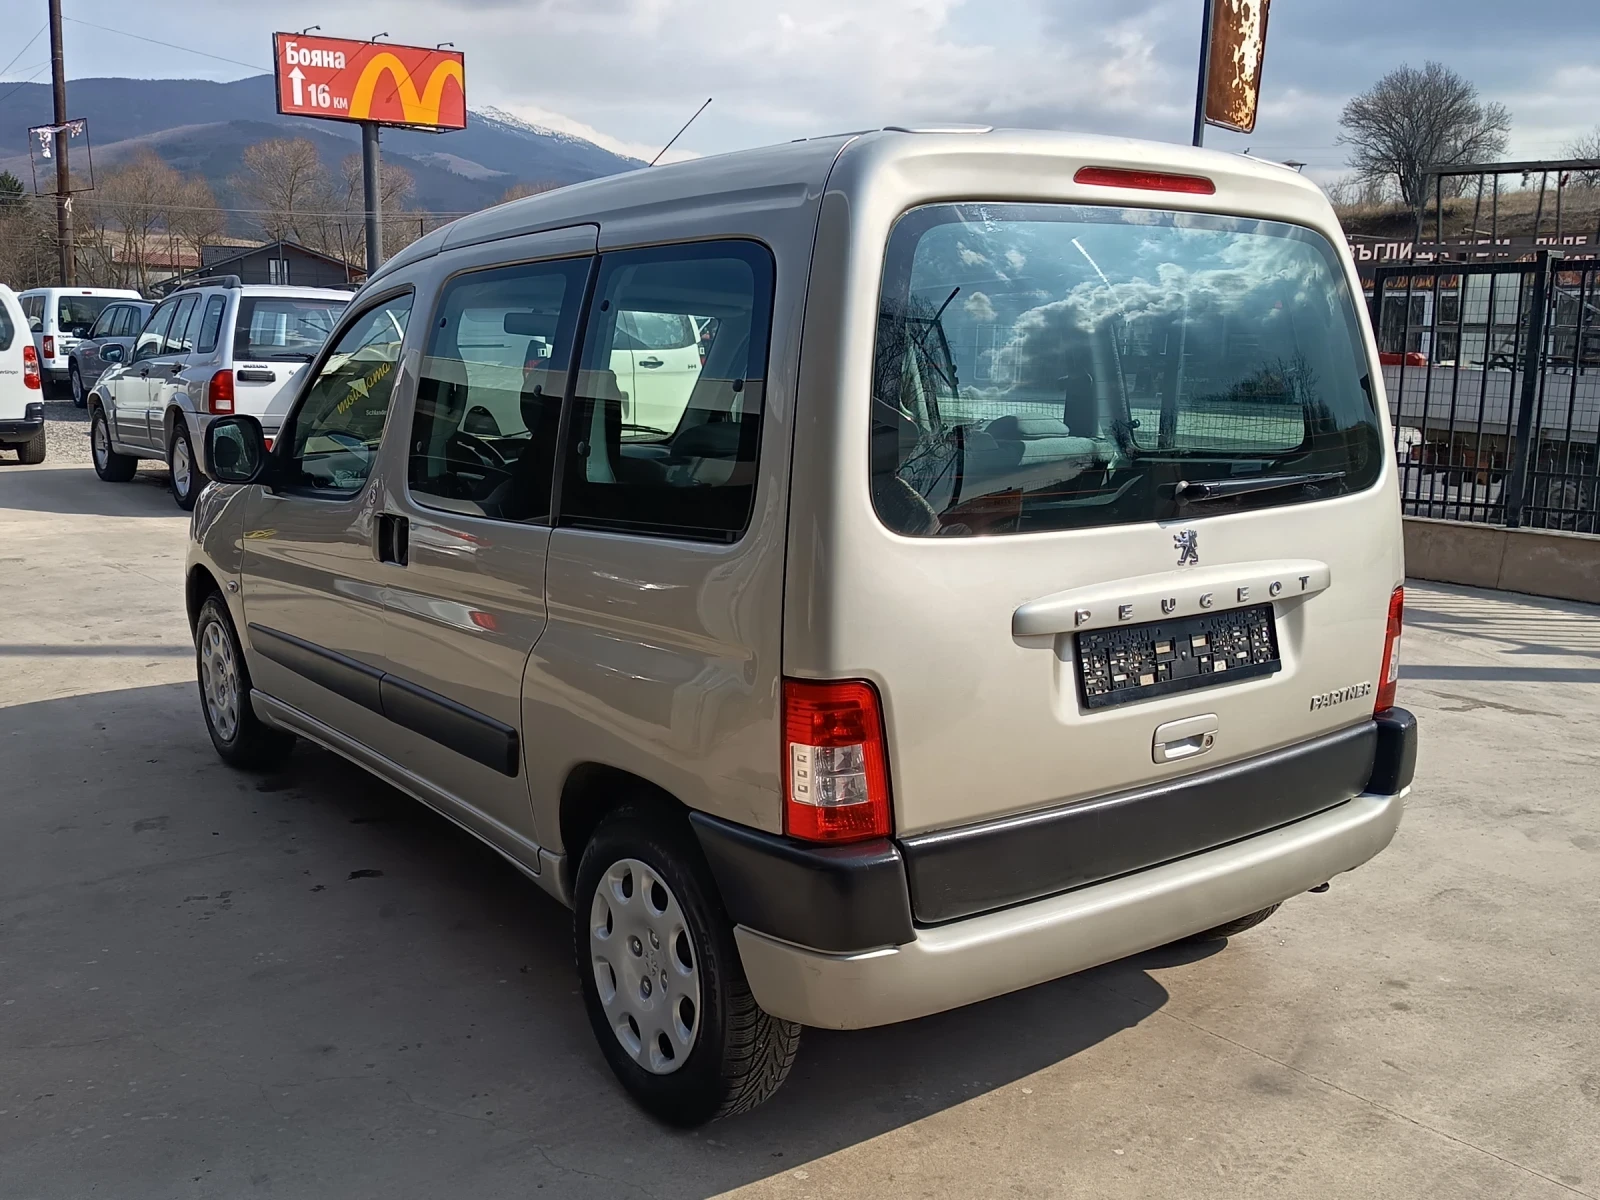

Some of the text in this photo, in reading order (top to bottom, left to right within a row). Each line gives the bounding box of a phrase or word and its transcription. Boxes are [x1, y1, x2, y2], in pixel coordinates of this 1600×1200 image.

[285, 41, 346, 69] Бояна
[307, 83, 331, 108] 16
[1073, 575, 1310, 628] PEUGEOT
[1310, 680, 1371, 712] PARTNER
